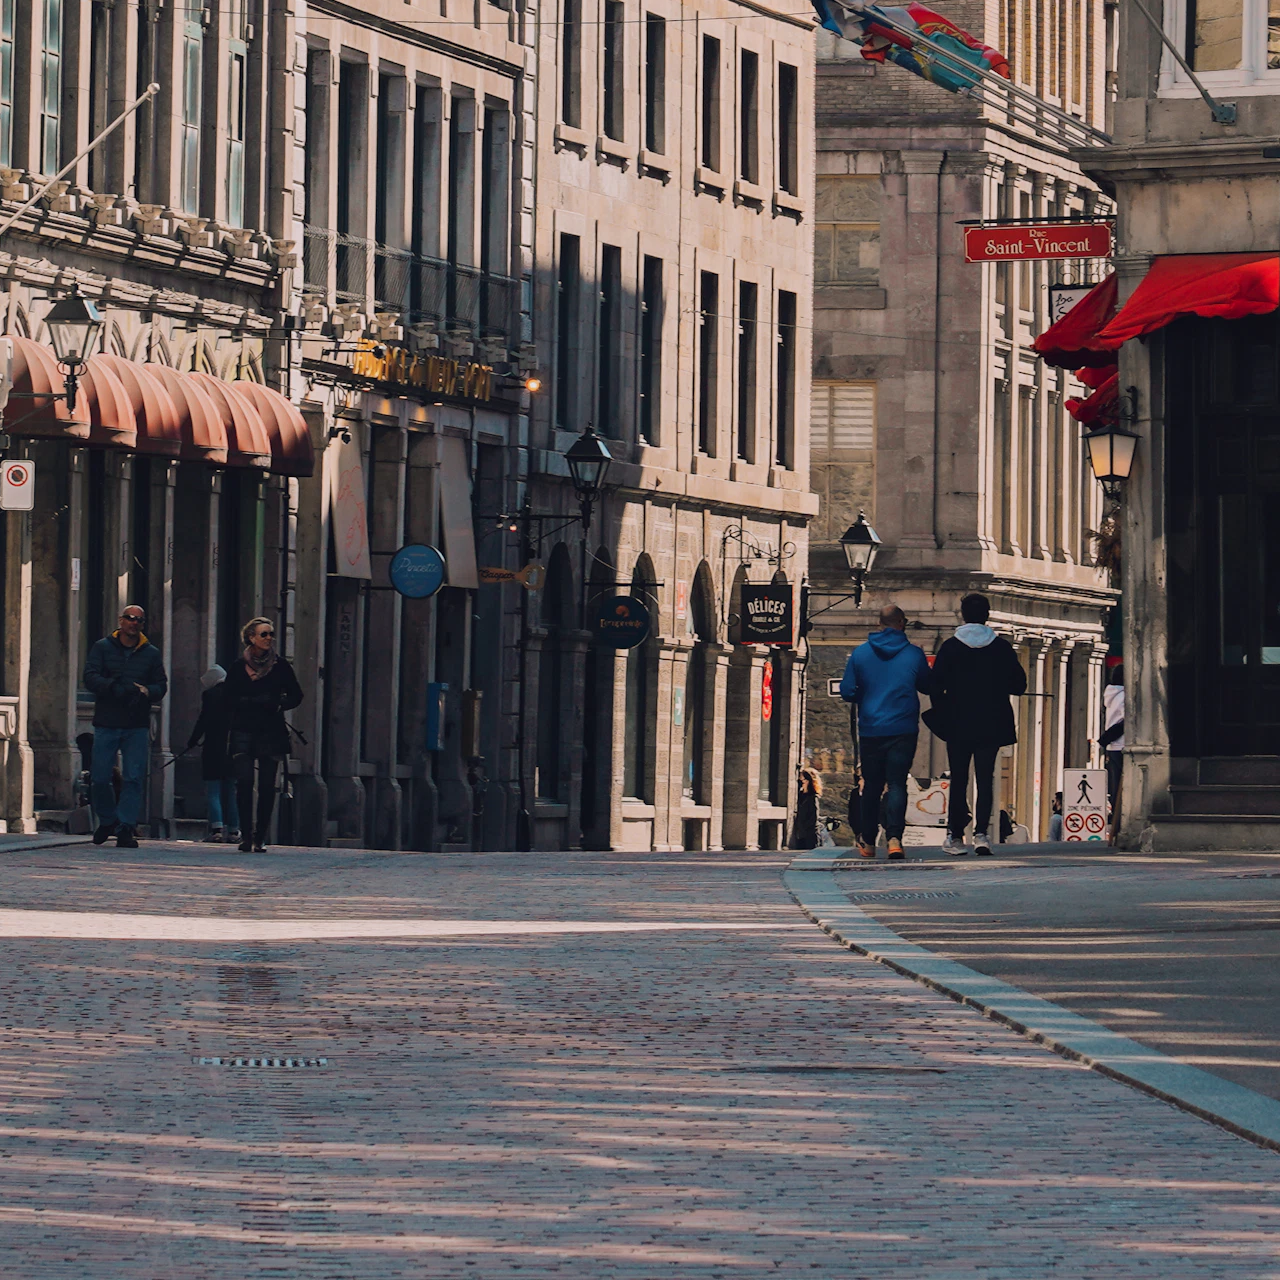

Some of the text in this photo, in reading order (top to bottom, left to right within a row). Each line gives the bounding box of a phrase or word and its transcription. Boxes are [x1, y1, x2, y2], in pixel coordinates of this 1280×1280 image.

[1029, 229, 1046, 238] Rue
[984, 237, 1092, 255] Saint-Vincent
[747, 595, 787, 616] DÉLICES
